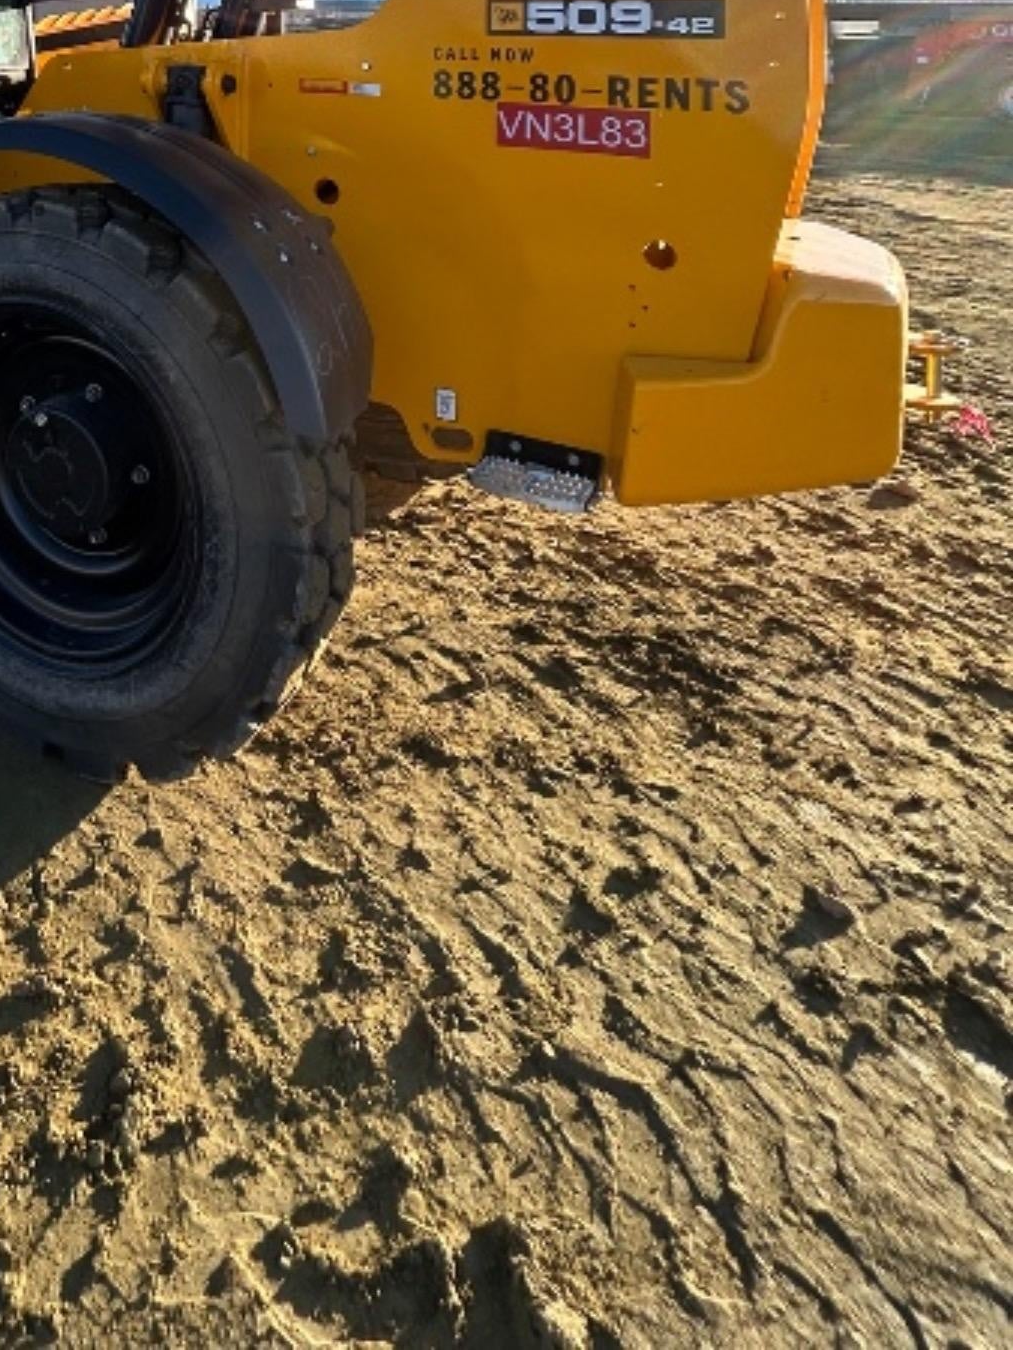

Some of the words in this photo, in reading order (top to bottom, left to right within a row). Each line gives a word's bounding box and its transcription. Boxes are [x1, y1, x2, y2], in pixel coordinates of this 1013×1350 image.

[433, 47, 480, 61] CALL
[490, 47, 535, 62] NOW
[433, 70, 751, 115] 888-80-RENTS
[498, 110, 647, 148] VN3L83
